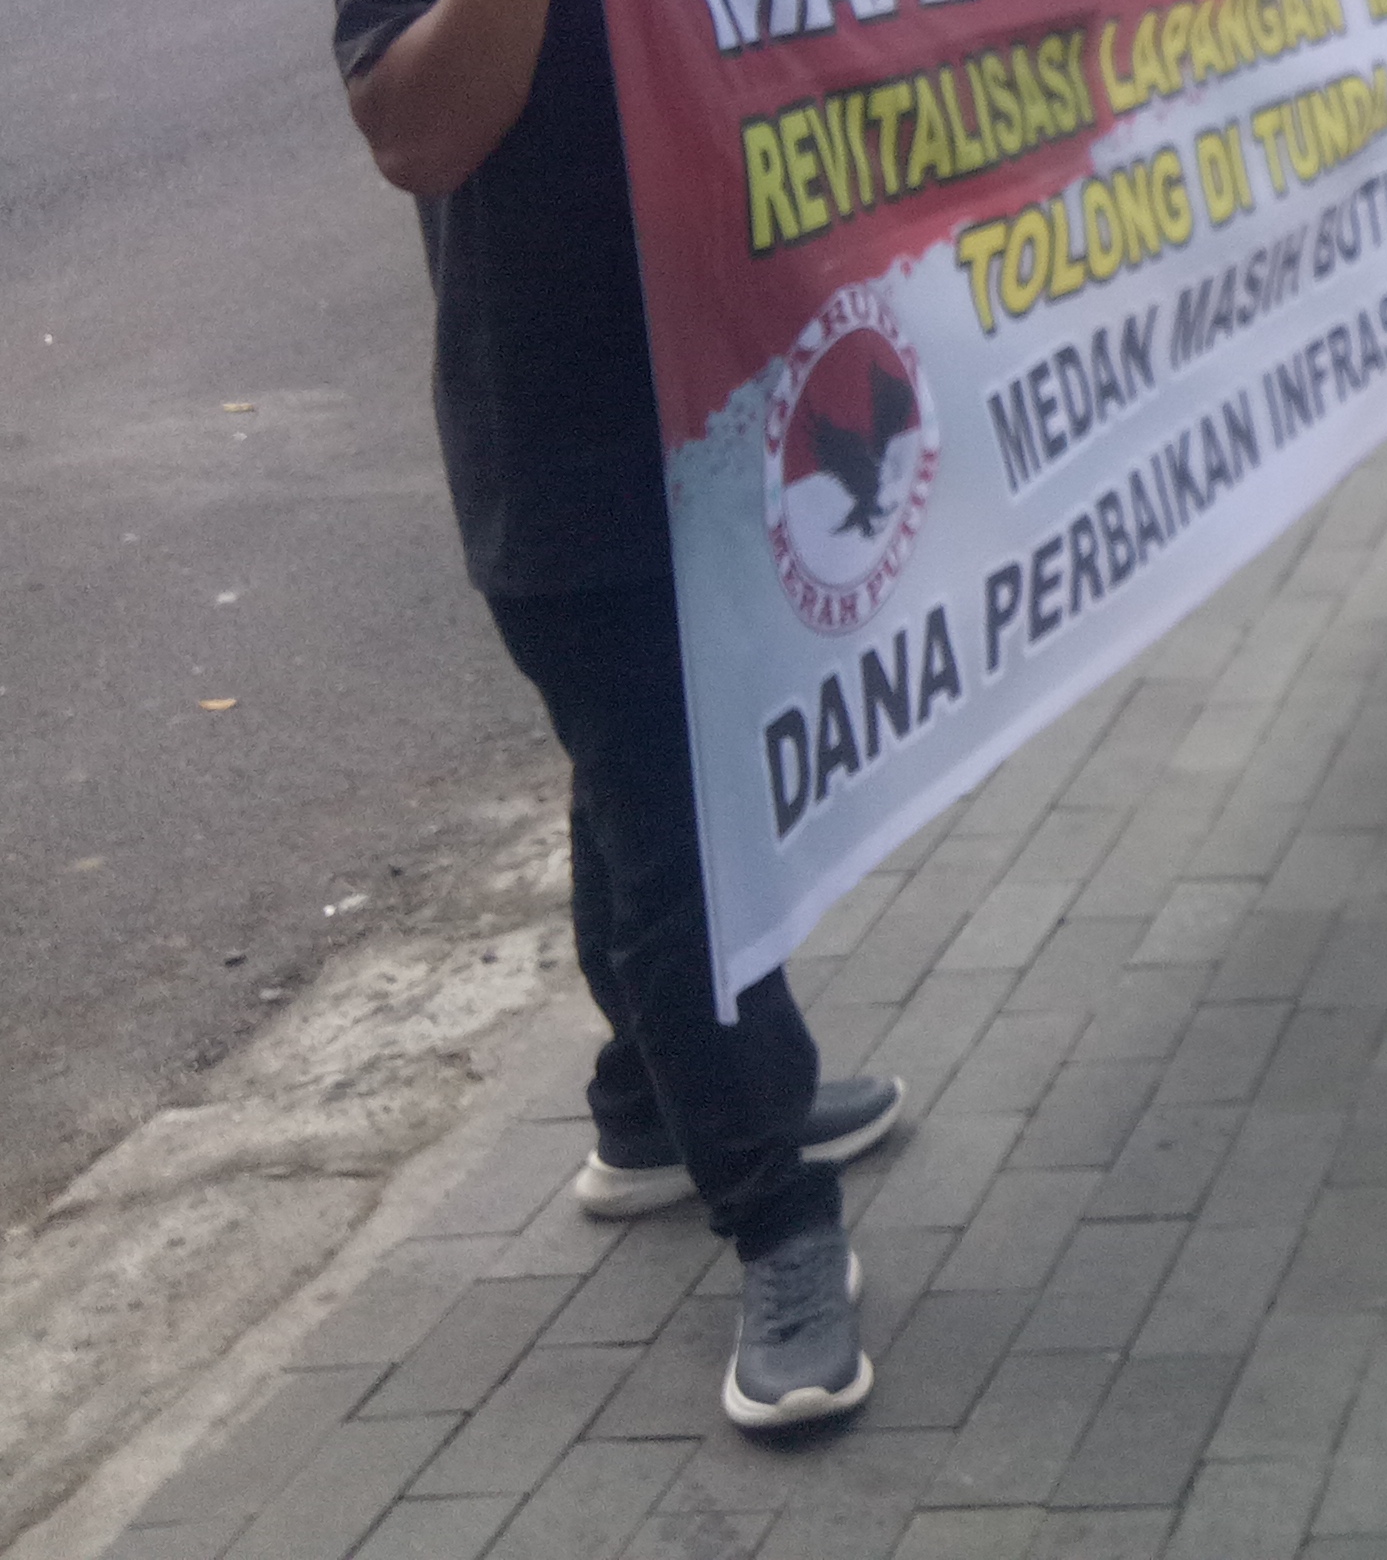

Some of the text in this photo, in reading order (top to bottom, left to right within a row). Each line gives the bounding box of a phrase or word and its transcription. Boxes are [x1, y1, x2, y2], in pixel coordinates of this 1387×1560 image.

[741, 28, 1096, 256] REVITALISASI
[957, 146, 1194, 335] TOLONG
[1196, 122, 1255, 227] DI
[987, 302, 1159, 496] MEDAN
[1169, 225, 1309, 372] MASIH
[764, 603, 962, 839] DANA
[984, 390, 1264, 674] PERBAIKAN
